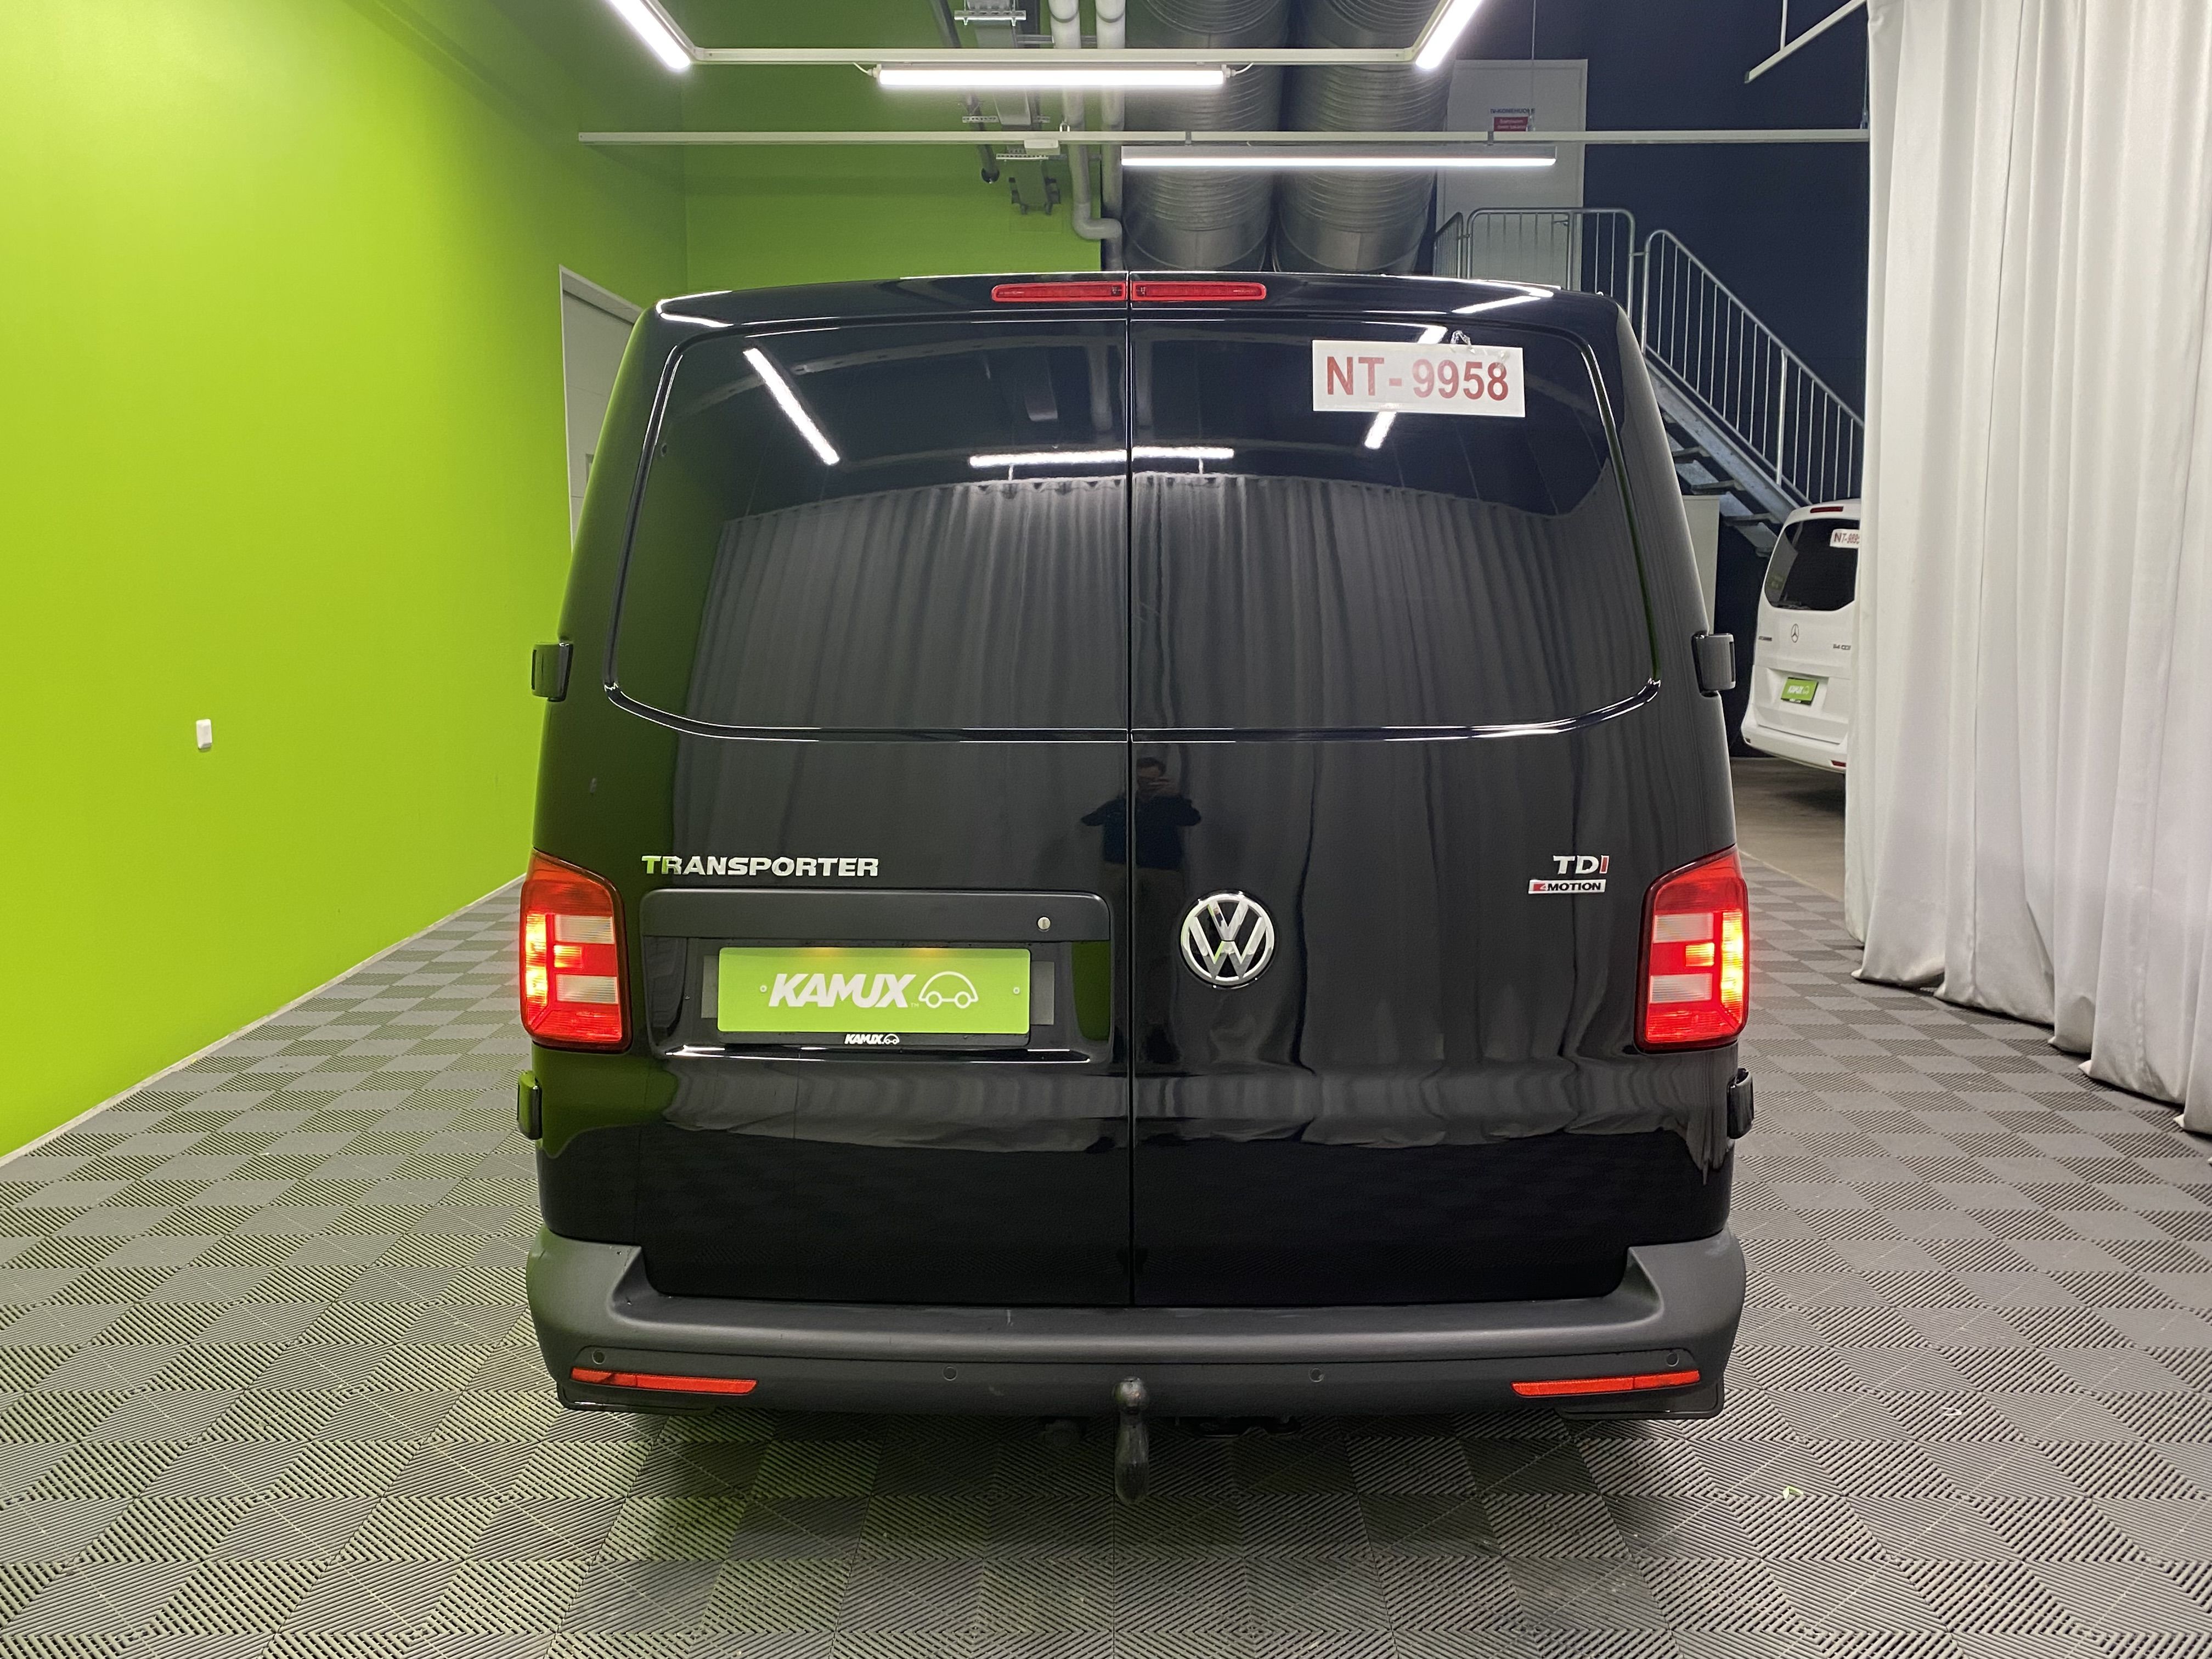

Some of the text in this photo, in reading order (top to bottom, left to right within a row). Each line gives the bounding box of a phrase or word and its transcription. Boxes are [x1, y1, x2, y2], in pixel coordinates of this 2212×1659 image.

[1326, 356, 1509, 401] NT-9958
[641, 855, 878, 877] TRANSPORTER
[1553, 855, 1610, 874] TDI
[768, 973, 916, 1008] KAMUX
[844, 1034, 884, 1045] KAMUX
